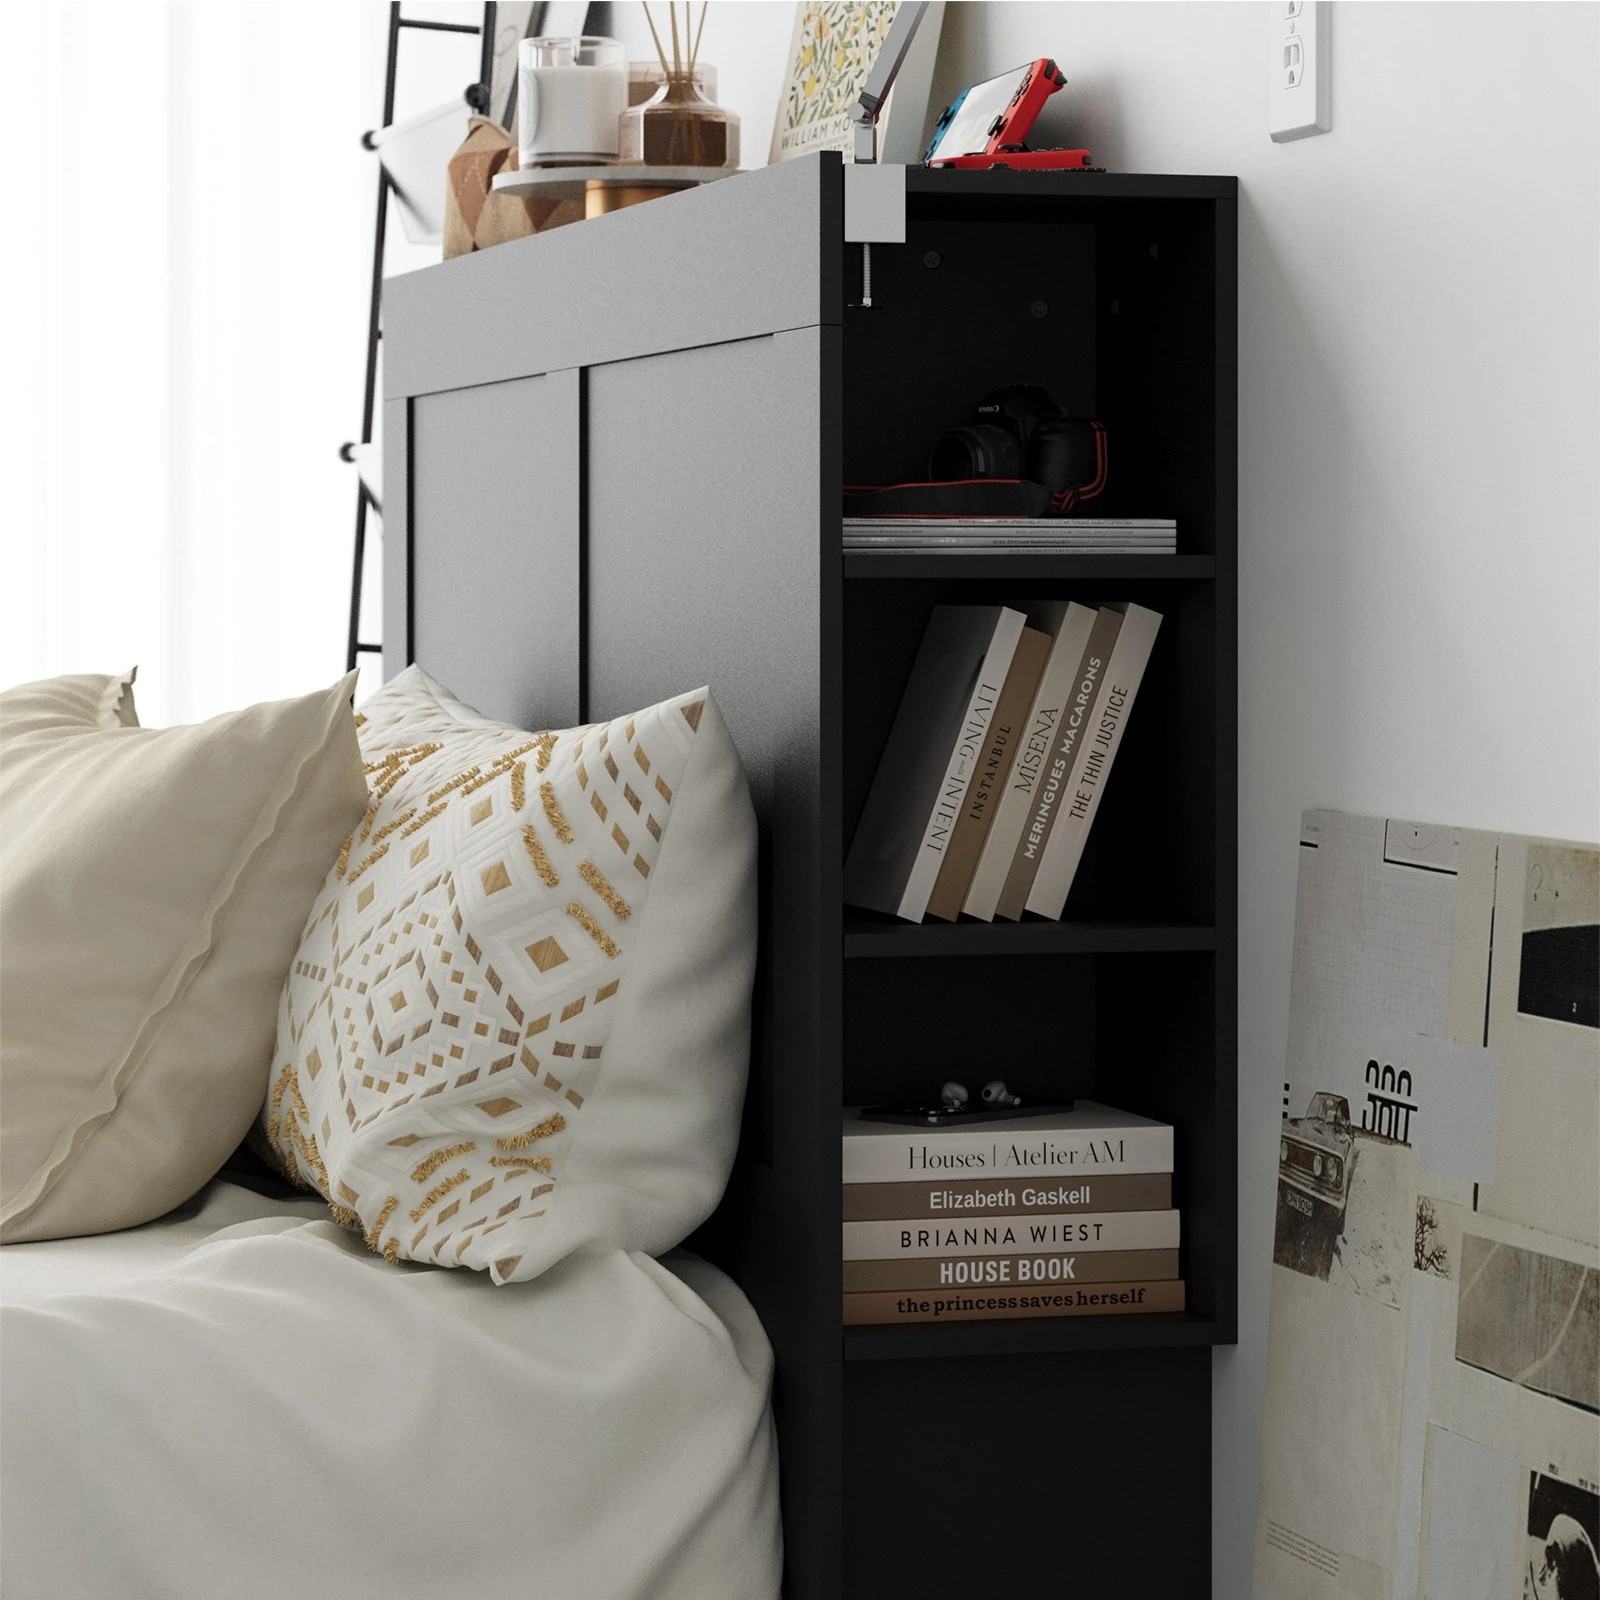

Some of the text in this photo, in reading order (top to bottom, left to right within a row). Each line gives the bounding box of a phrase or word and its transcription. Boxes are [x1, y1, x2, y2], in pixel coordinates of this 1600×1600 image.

[781, 123, 829, 149] WILLIAM
[833, 116, 854, 135] MO
[959, 684, 997, 761] LIVING
[1024, 657, 1101, 859] MERINGUES MACARONS
[1069, 685, 1128, 820] THE THIN JUSTICE
[969, 725, 1011, 820] INSTANBUL
[927, 777, 965, 855] INTENT
[908, 1140, 1125, 1169] Houses Atelier AM
[930, 1186, 1090, 1209] Elizabeth Gaskell
[901, 1224, 1103, 1248] BRIANNA WIEST
[940, 1258, 1076, 1283] HOUSE BOOK
[897, 1289, 1146, 1316] the princess saves herself
